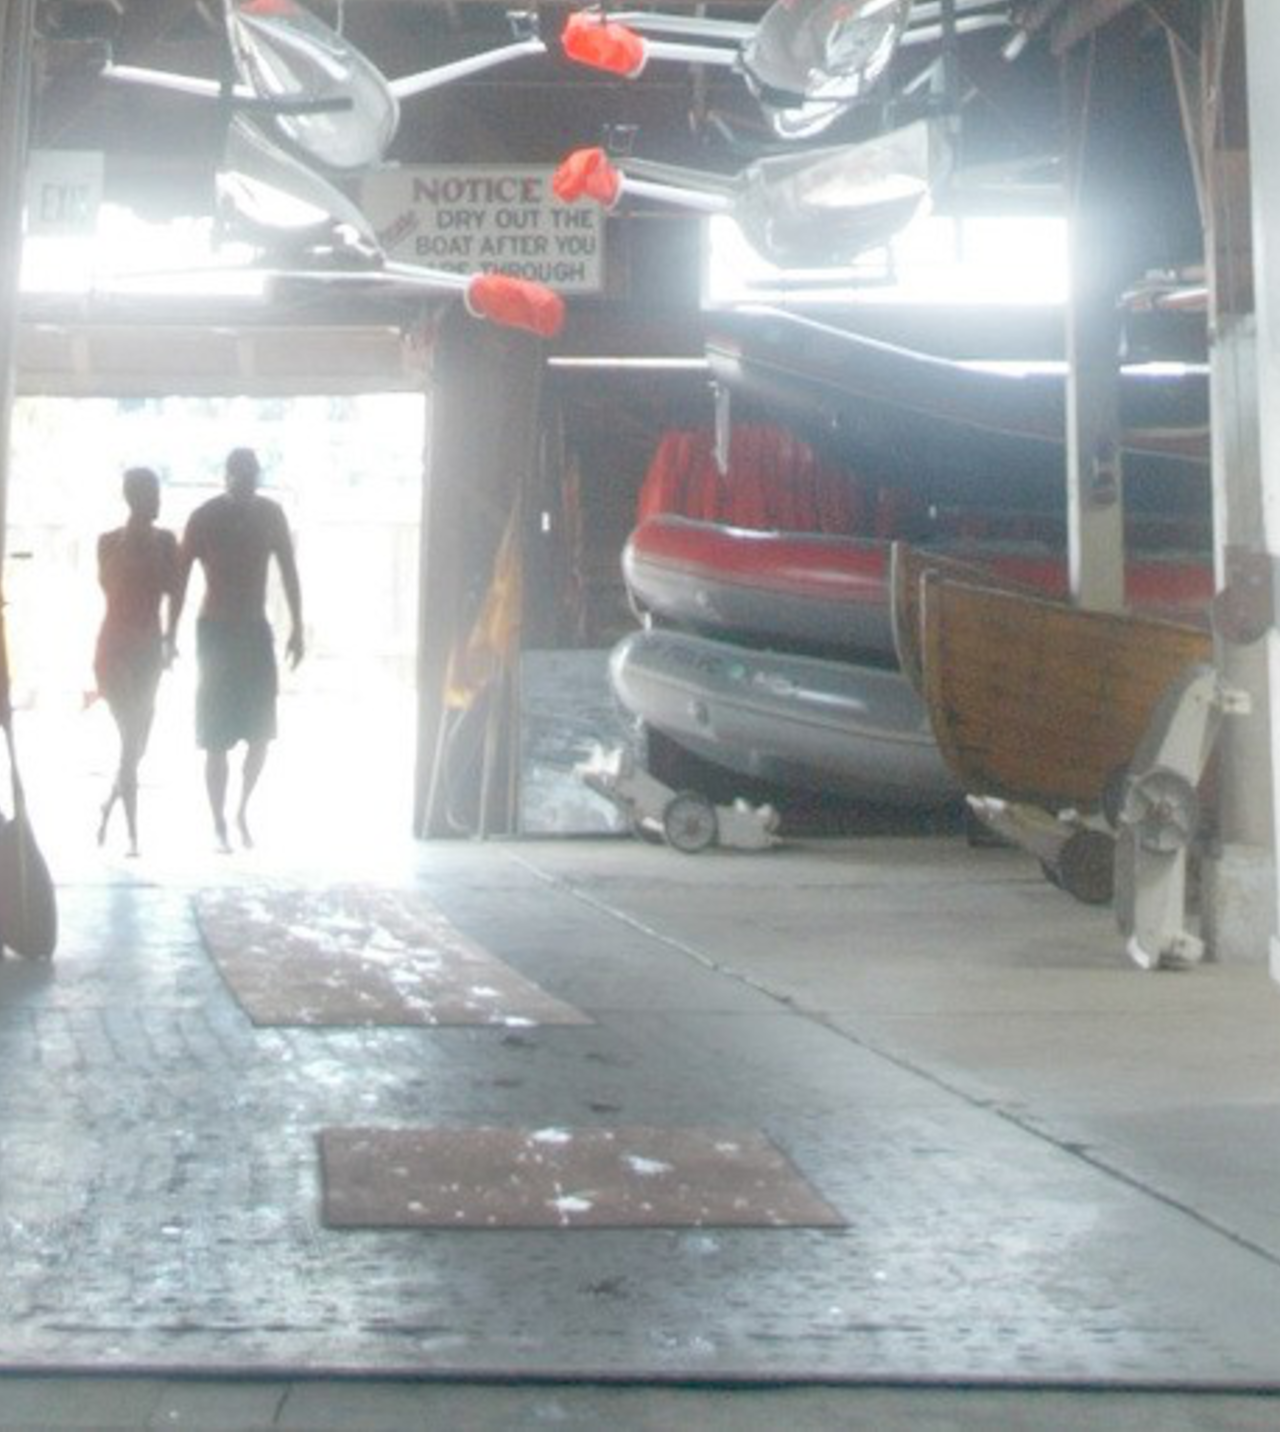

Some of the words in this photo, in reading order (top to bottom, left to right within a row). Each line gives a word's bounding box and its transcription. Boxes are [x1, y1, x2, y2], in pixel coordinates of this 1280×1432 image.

[413, 176, 542, 204] NOTICE
[436, 209, 487, 230] DRY
[494, 209, 540, 229] OUT
[551, 209, 594, 229] THE
[415, 235, 473, 256] BOAT
[480, 235, 549, 256] AFTER
[554, 235, 596, 255] YOU
[480, 261, 585, 282] THROUGH
